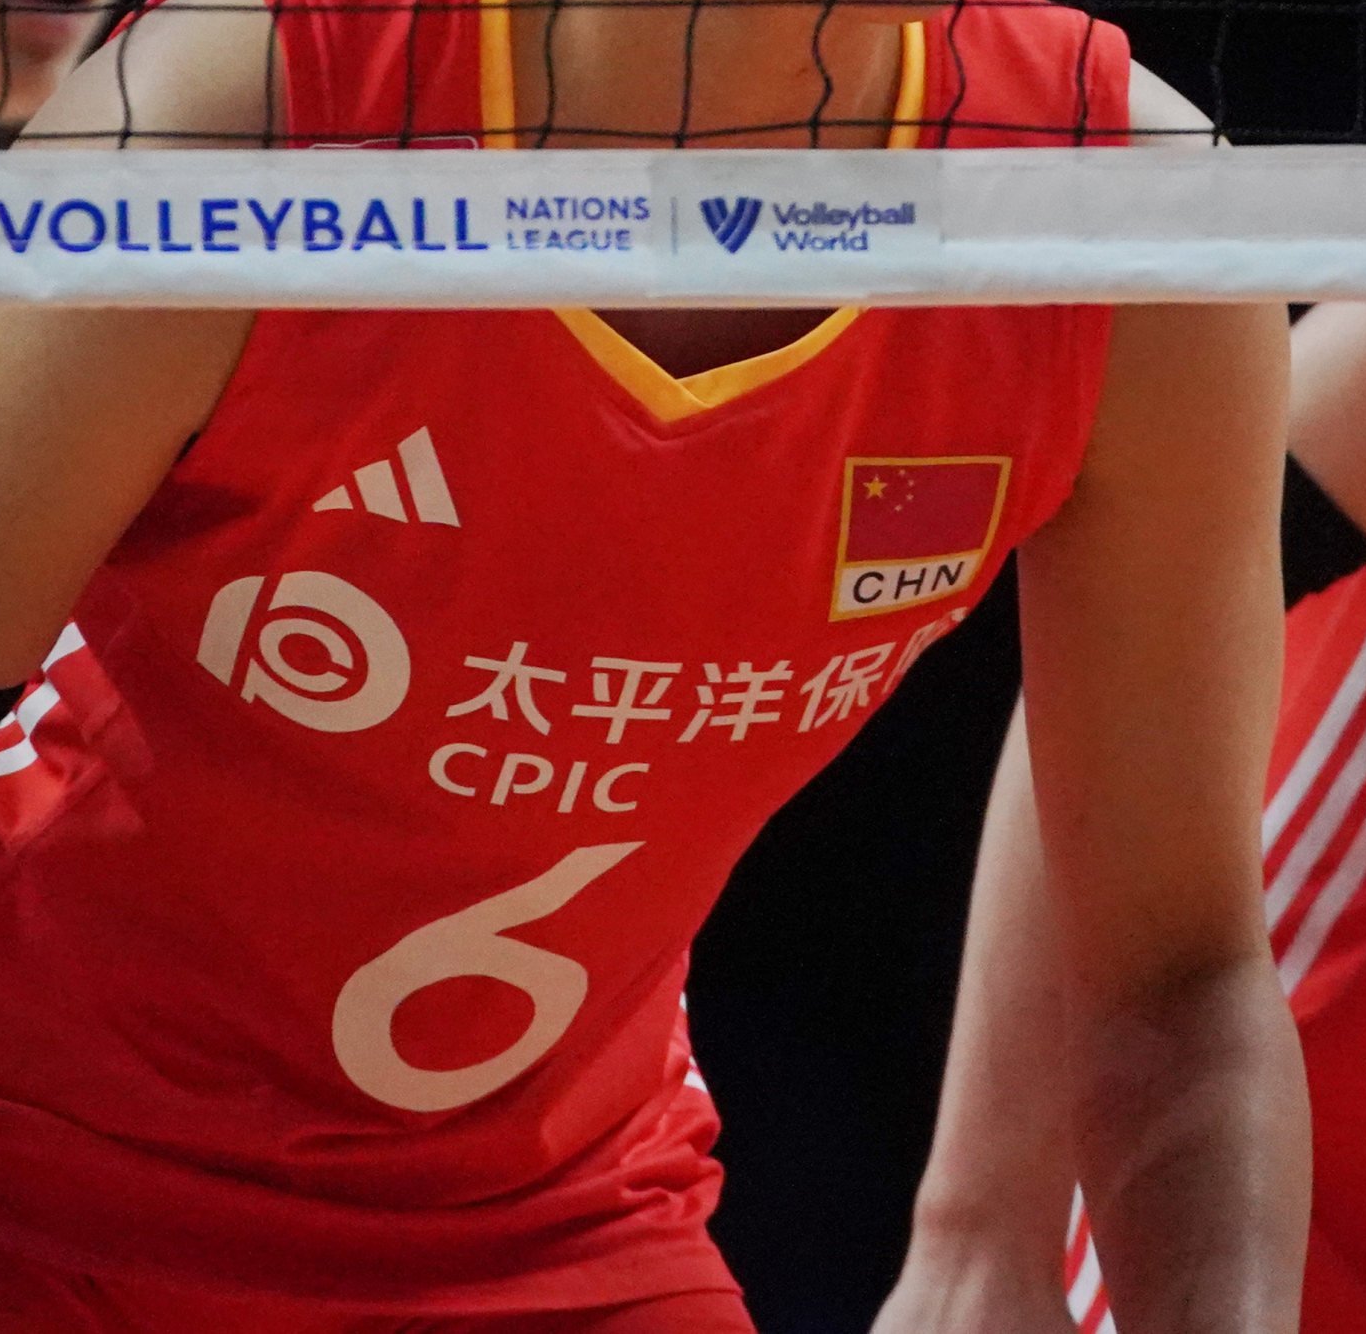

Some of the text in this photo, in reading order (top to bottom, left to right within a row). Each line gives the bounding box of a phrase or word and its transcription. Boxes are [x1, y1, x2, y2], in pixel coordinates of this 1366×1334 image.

[505, 196, 651, 222] NATIONS
[772, 200, 917, 231] Volleyball
[506, 229, 633, 252] LEAGUE
[772, 230, 869, 252] World
[852, 560, 966, 605] CHN
[428, 741, 650, 815] CPIC
[331, 840, 646, 1113] 6
